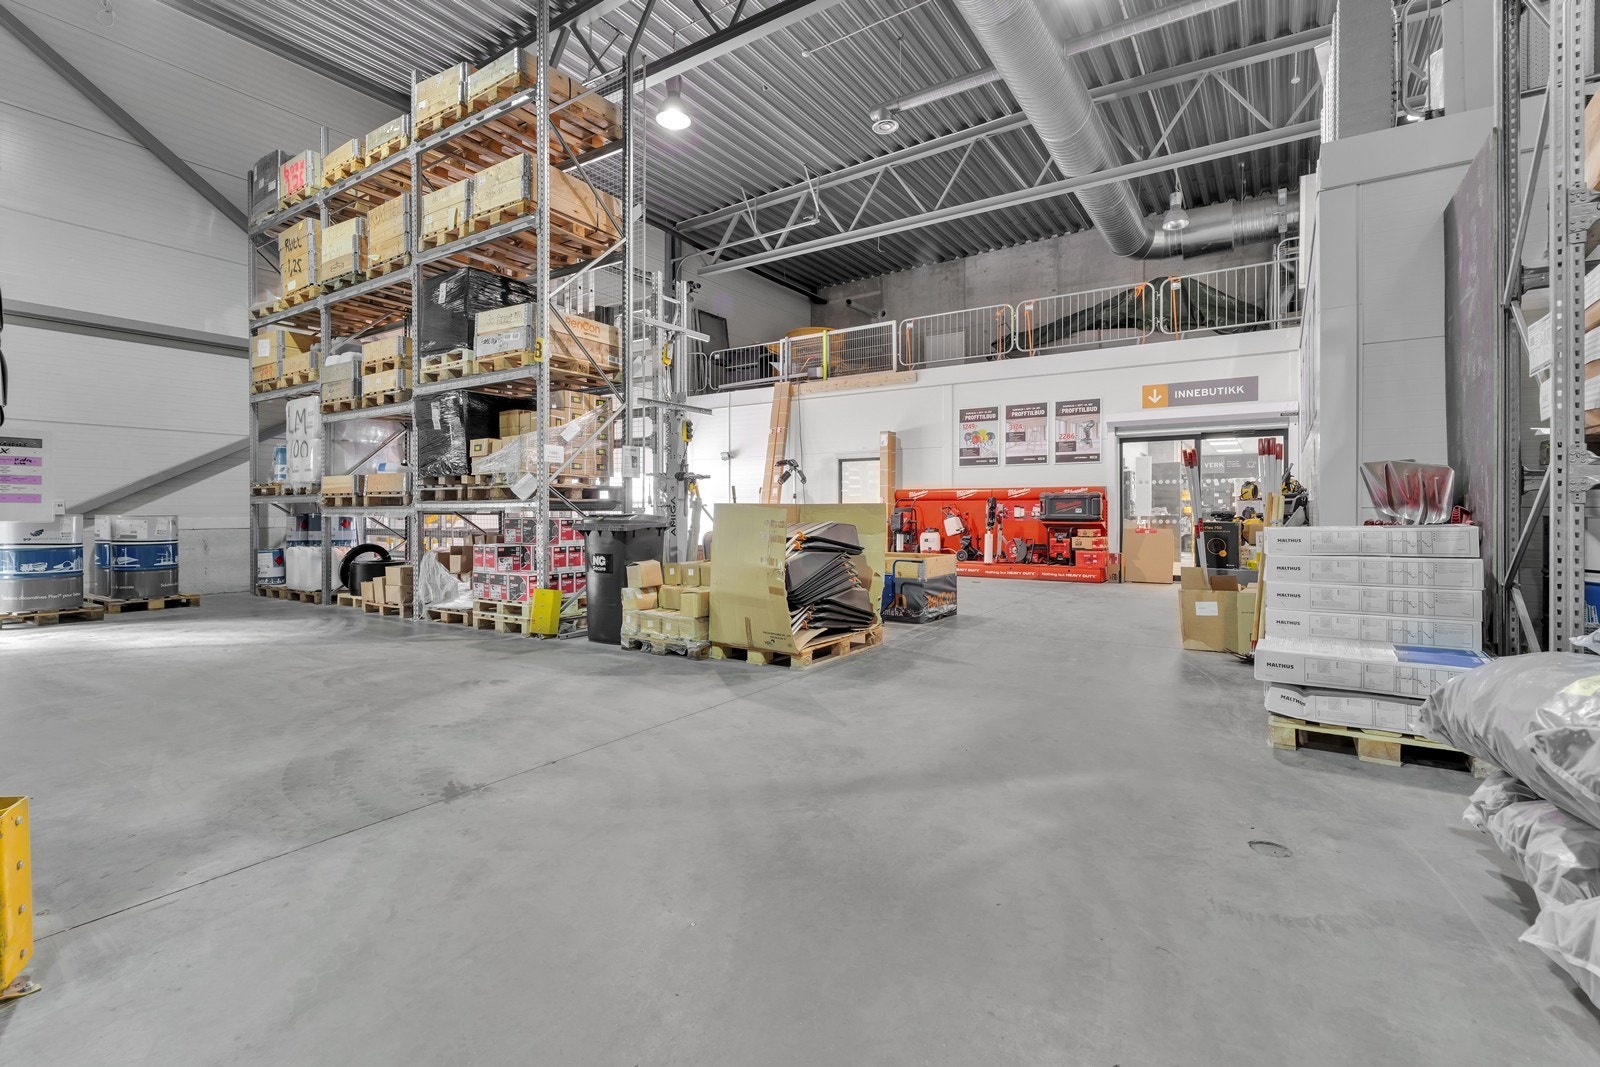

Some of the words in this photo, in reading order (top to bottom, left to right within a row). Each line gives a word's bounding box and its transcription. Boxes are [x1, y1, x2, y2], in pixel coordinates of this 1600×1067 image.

[1174, 385, 1245, 399] INNEBUTIKK
[1061, 406, 1098, 414] PROFFTILBUD
[964, 413, 997, 421] PROFFTILBUD
[592, 555, 606, 566] NG
[1280, 694, 1306, 706] MALTHUS
